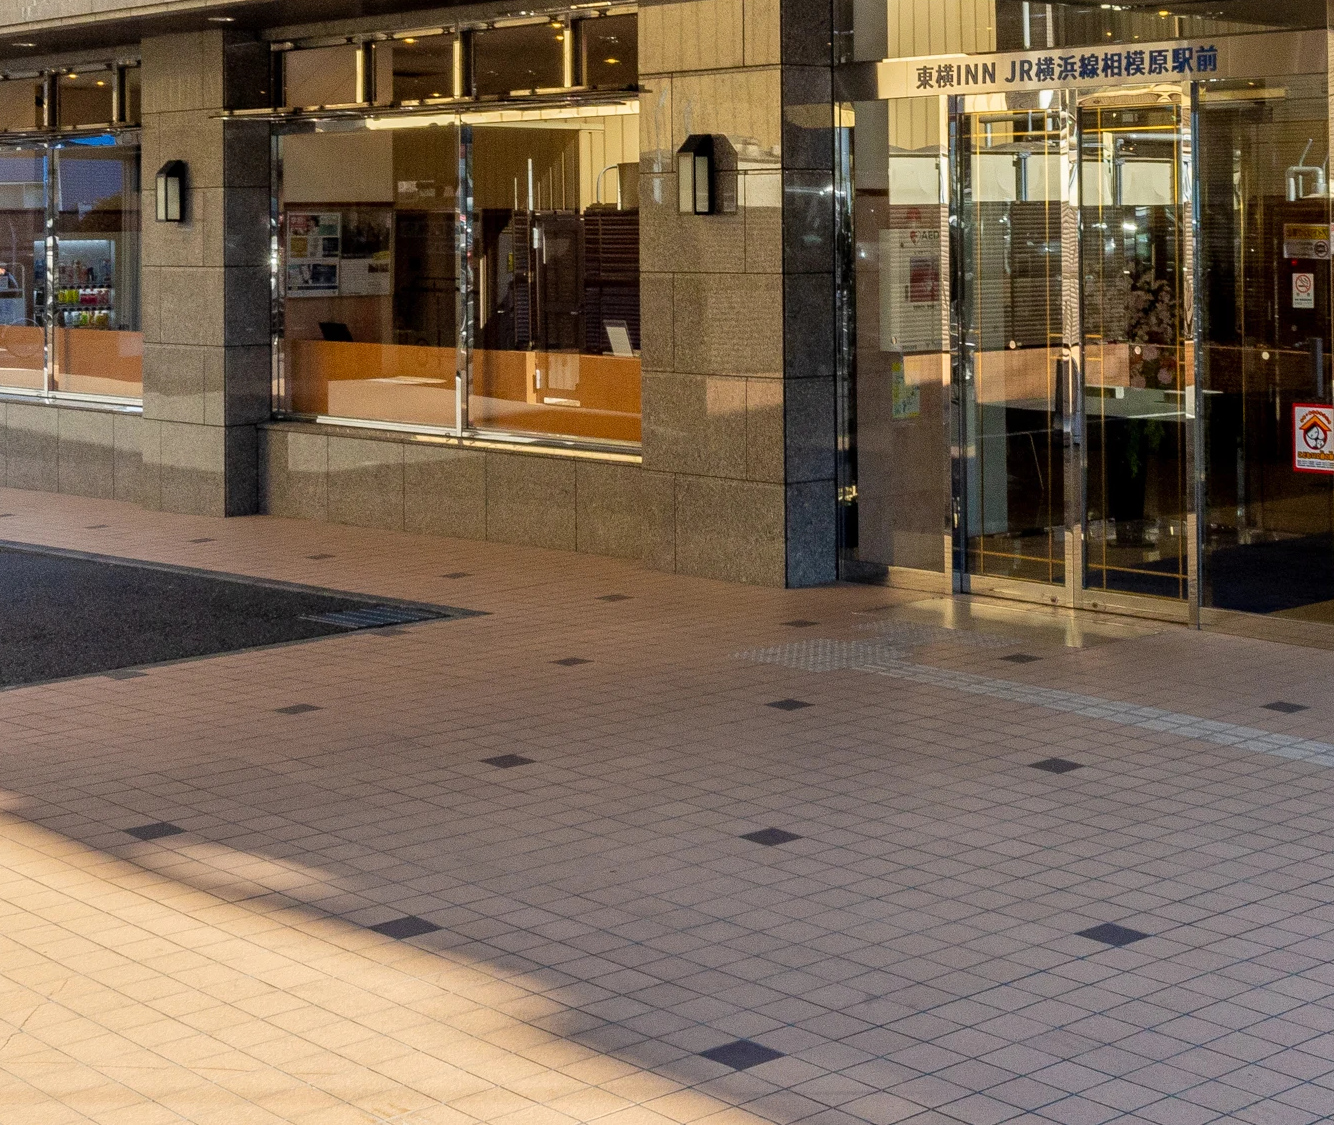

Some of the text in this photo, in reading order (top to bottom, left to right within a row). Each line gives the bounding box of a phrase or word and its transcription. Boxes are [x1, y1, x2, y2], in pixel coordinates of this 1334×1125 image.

[916, 44, 1218, 90] 東横INN JR横浜線相模原駅前
[921, 230, 940, 240] AED
